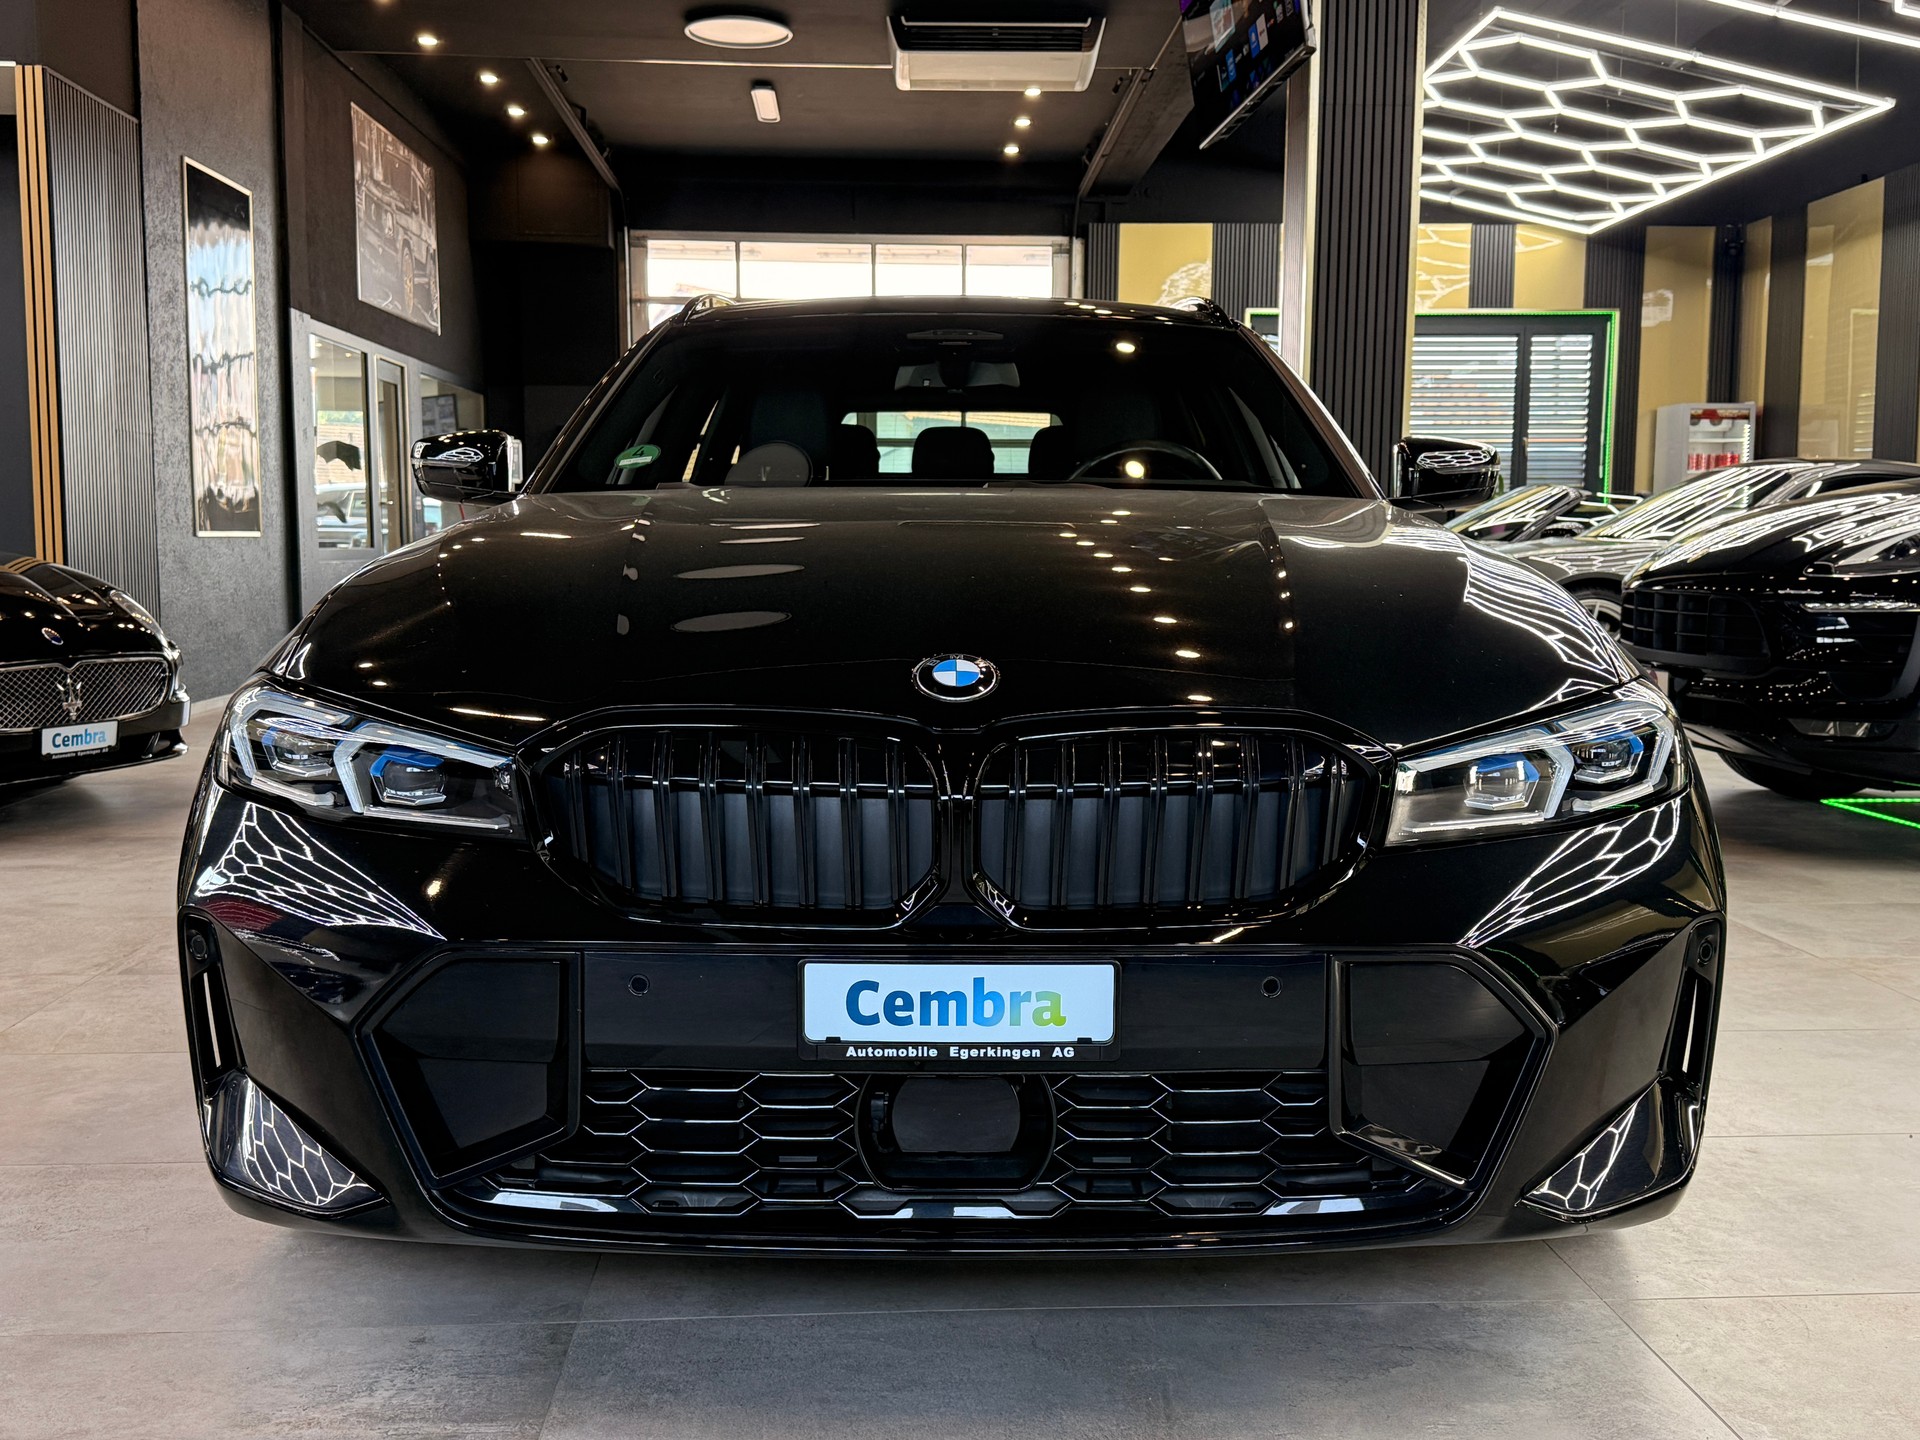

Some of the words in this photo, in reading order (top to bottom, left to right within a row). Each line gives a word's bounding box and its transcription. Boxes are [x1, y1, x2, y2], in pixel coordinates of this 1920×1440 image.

[631, 446, 645, 457] 4
[51, 728, 107, 749] Cembra
[845, 976, 1067, 1027] Cembra
[846, 1046, 938, 1058] Automobile
[949, 1046, 1041, 1060] Egerkingen
[1052, 1046, 1075, 1058] AG
